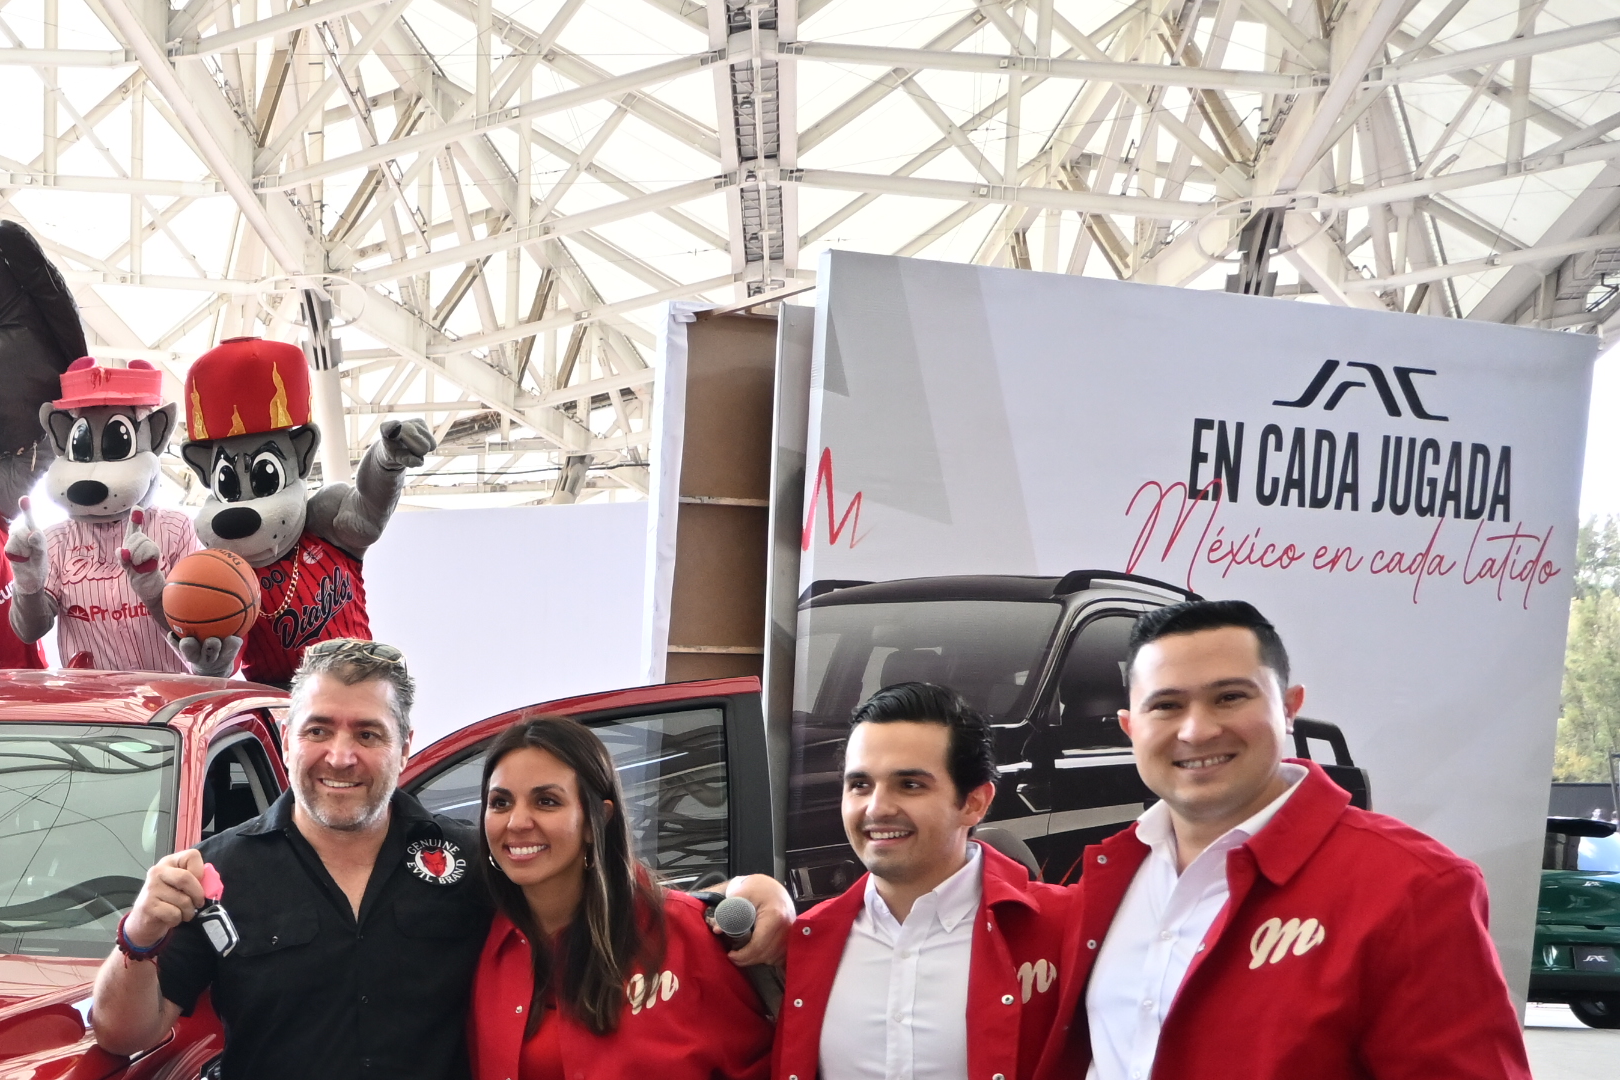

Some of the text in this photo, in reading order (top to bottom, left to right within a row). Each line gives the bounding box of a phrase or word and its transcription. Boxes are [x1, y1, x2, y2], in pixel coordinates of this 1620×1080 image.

[1272, 359, 1449, 421] JAC
[1187, 418, 1512, 523] EN CADA JUGADA
[1124, 477, 1561, 610] México en cada latido
[272, 565, 354, 650] Diablos
[406, 838, 460, 855] GENUINE
[406, 858, 467, 885] EVIL BRAND
